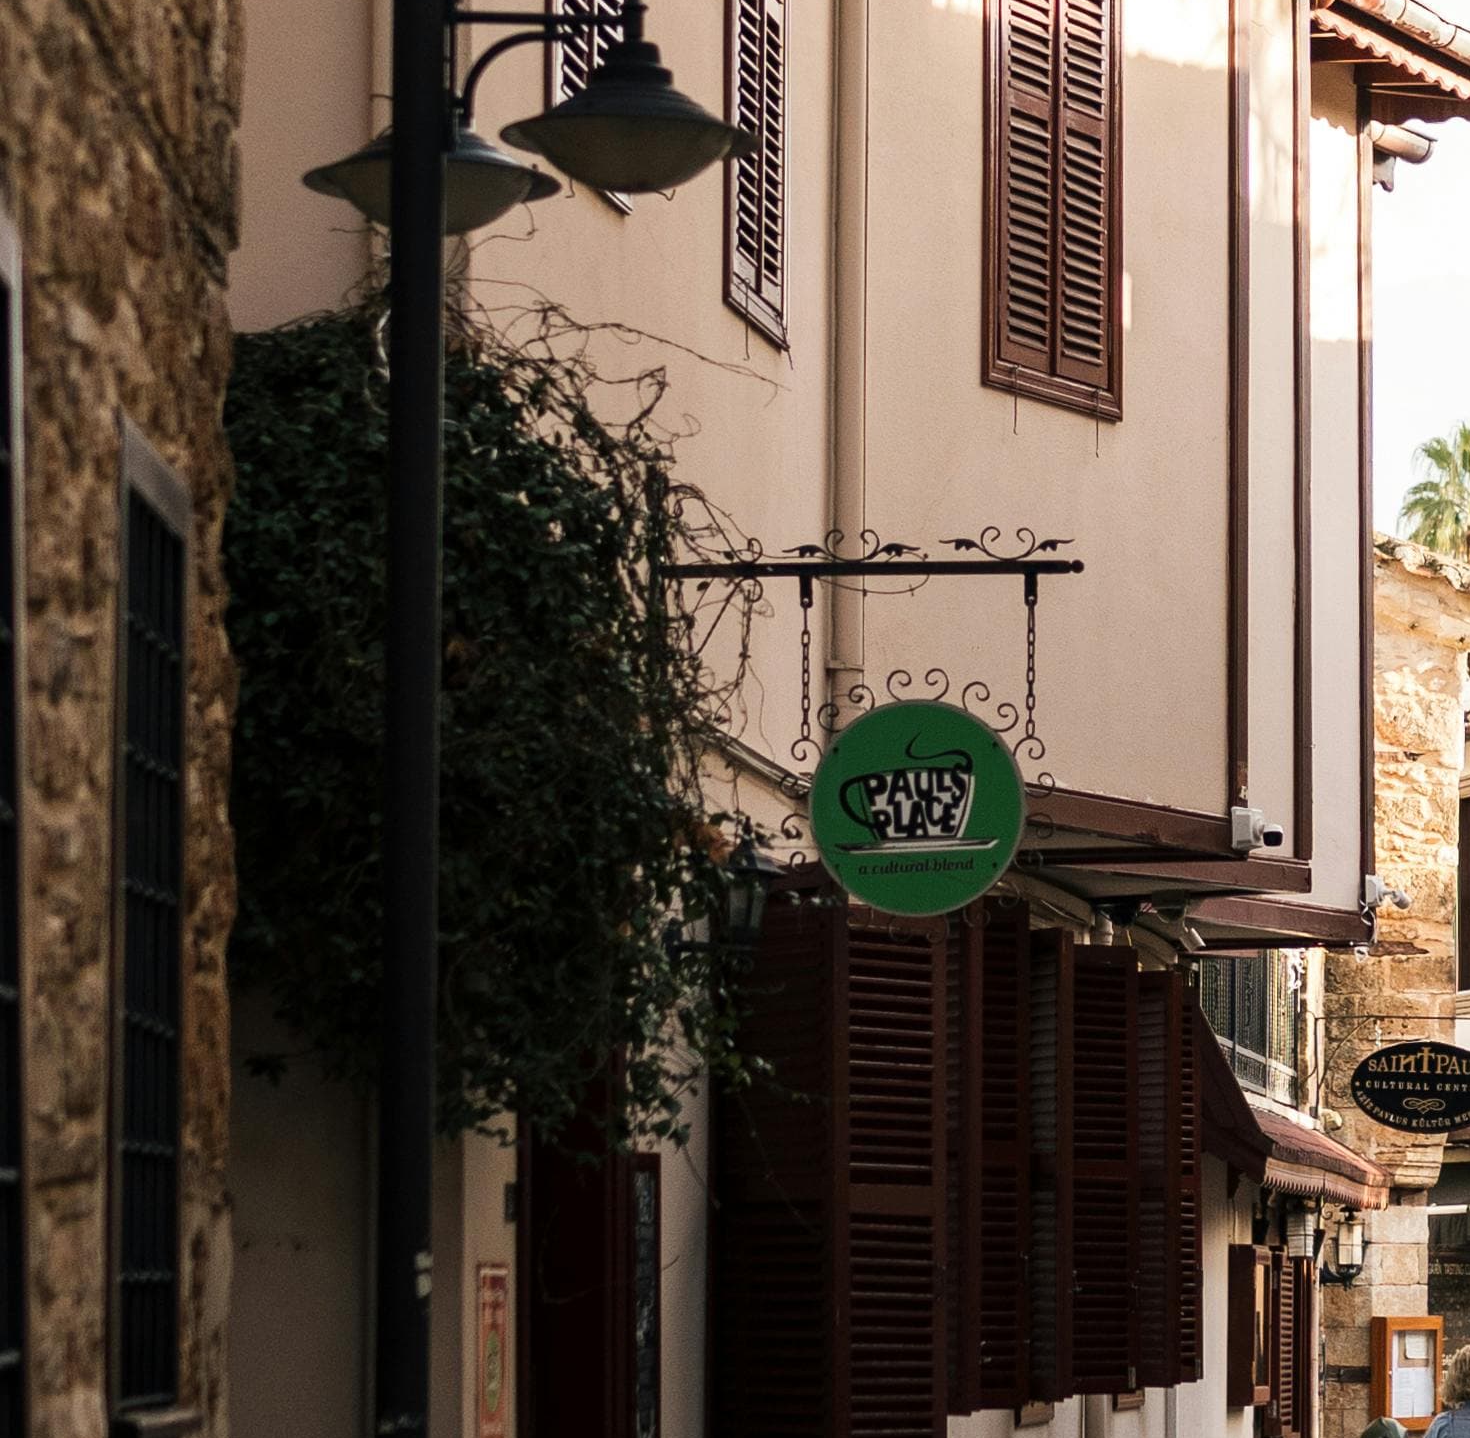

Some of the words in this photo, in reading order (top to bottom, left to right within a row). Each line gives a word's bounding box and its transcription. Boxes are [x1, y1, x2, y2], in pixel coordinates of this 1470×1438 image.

[872, 796, 957, 838] PLACE
[858, 865, 868, 875] a
[871, 858, 929, 875] cultural
[932, 857, 974, 872] blend
[1365, 1080, 1430, 1091] CULTURAL
[1372, 1106, 1409, 1126] PAVLUS
[1411, 1117, 1452, 1128] KÜLTÜR
